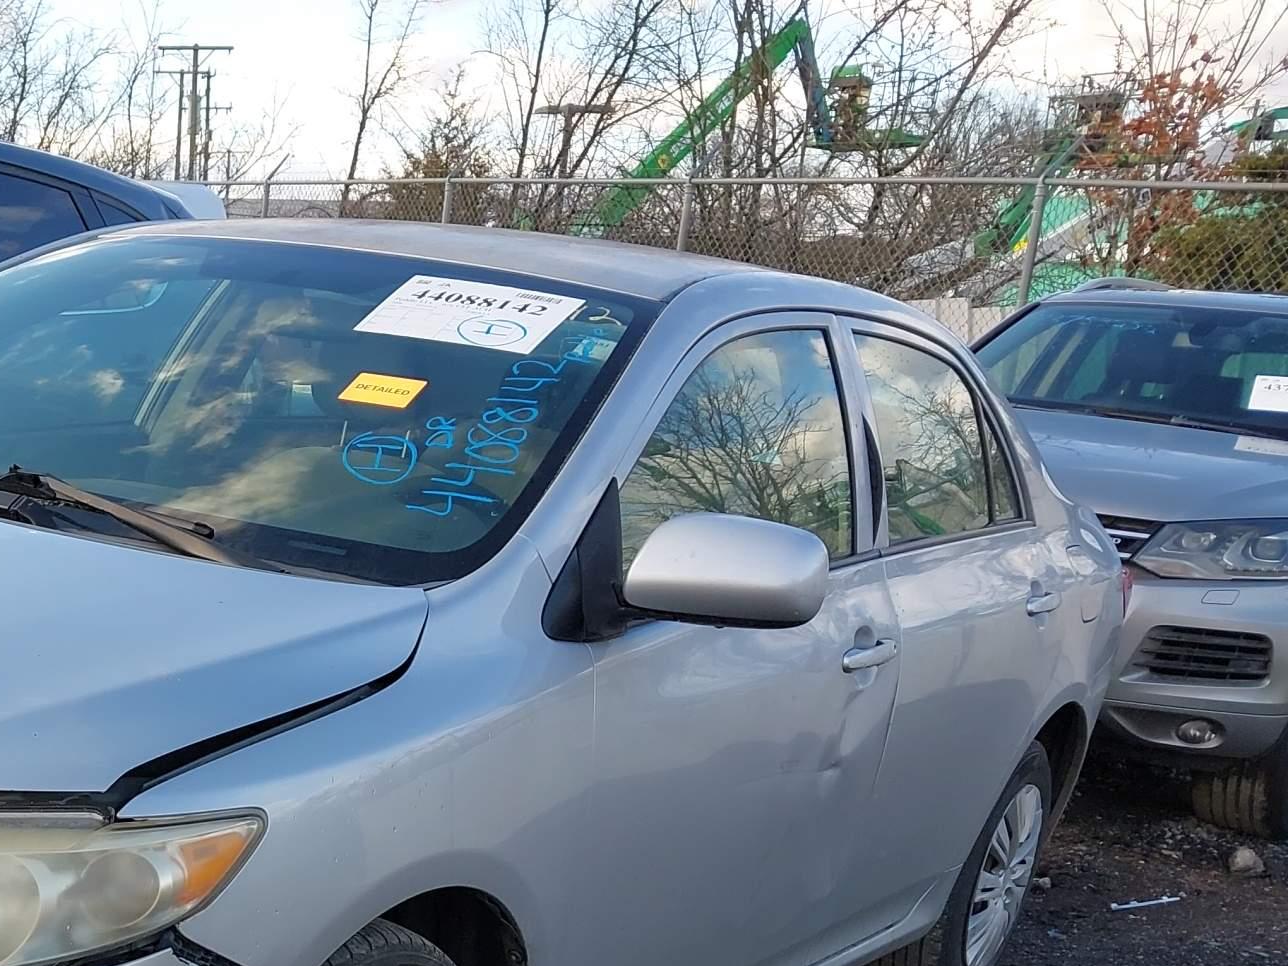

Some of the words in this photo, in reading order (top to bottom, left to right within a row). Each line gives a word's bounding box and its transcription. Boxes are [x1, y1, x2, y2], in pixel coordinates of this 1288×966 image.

[411, 288, 549, 317] 44088142
[354, 382, 411, 398] DETAILED
[405, 359, 562, 517] 44088142
[424, 415, 458, 449] DR
